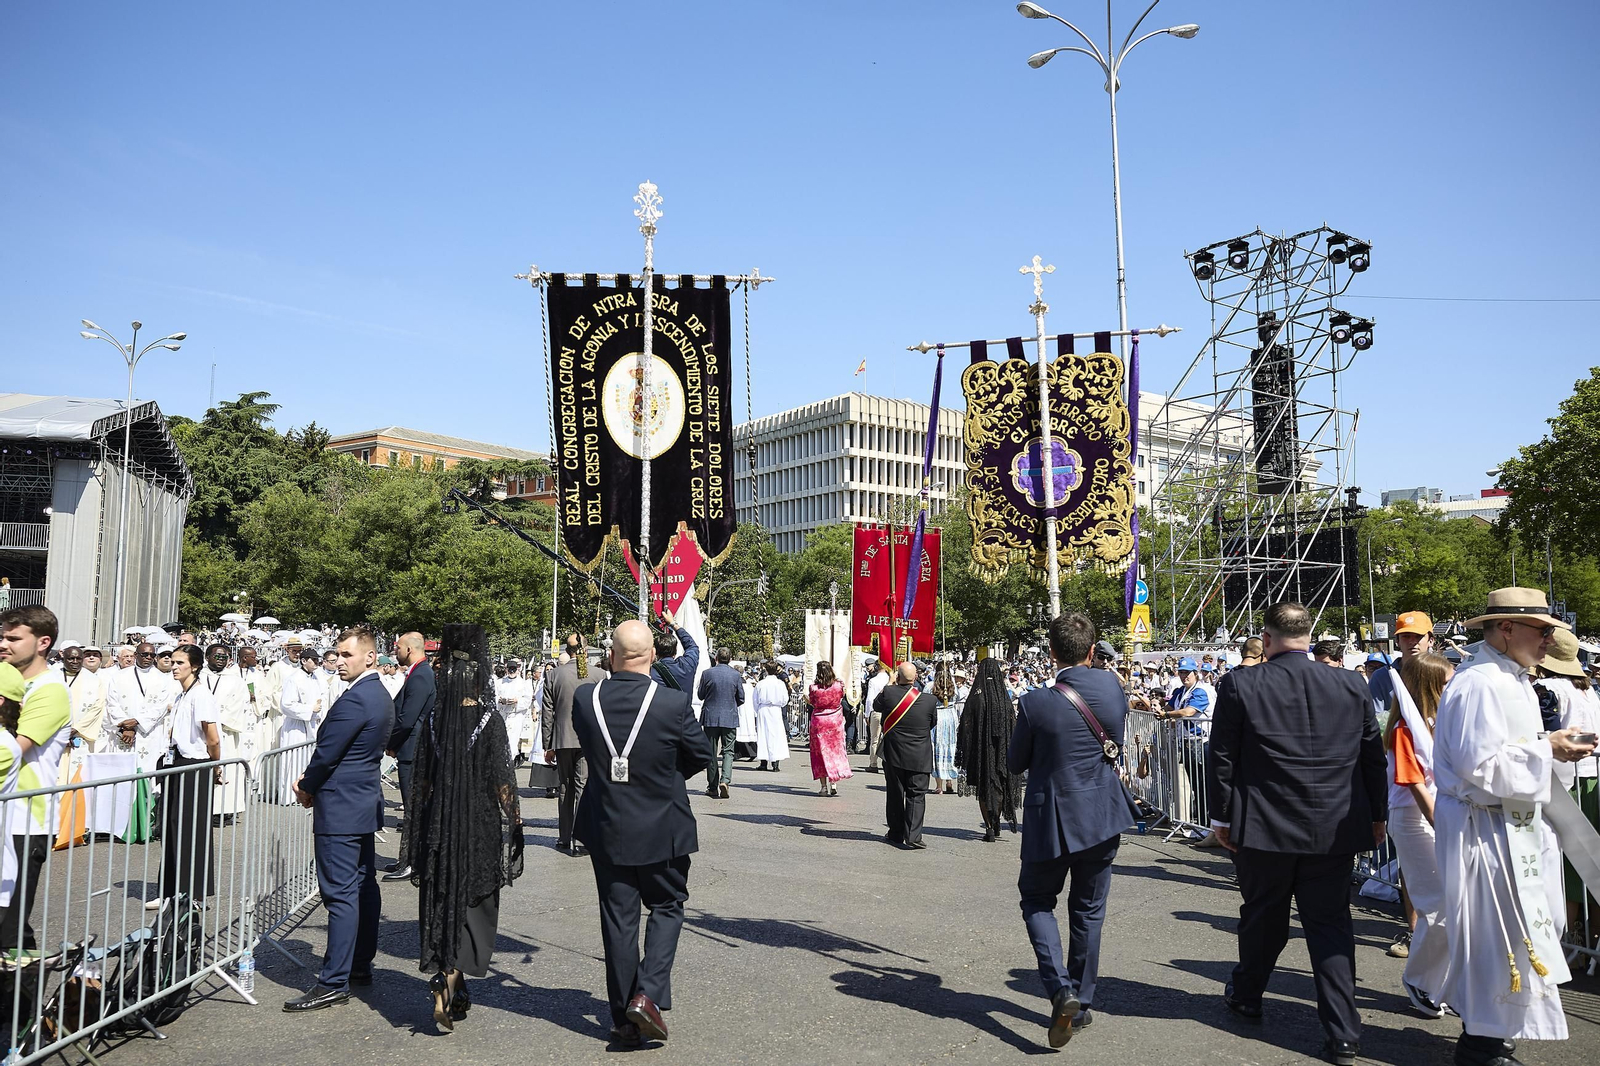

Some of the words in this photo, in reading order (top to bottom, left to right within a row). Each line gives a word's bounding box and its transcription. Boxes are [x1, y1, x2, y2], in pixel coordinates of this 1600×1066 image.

[592, 292, 637, 317] NTRA
[651, 293, 679, 316] SRA
[569, 314, 591, 340] DE
[617, 314, 629, 329] Y
[684, 314, 706, 337] DE
[581, 321, 618, 372] AGONIA
[702, 342, 718, 375] LOS
[581, 379, 596, 401] LA
[559, 346, 579, 470] CONGREGACION
[582, 407, 597, 428] DE
[707, 385, 720, 432] SIETE
[1025, 399, 1102, 441] NZARENO
[689, 421, 703, 442] DE
[1011, 426, 1030, 443] EL
[1031, 417, 1078, 439] PBRE
[584, 433, 600, 486] CRISTO
[690, 448, 703, 470] LA
[708, 442, 723, 519] DOLORES
[565, 481, 581, 526] REAL
[587, 493, 601, 526] DEL
[691, 477, 705, 519] CRUZ
[865, 544, 878, 559] DE
[866, 615, 919, 629] ALPERETE
